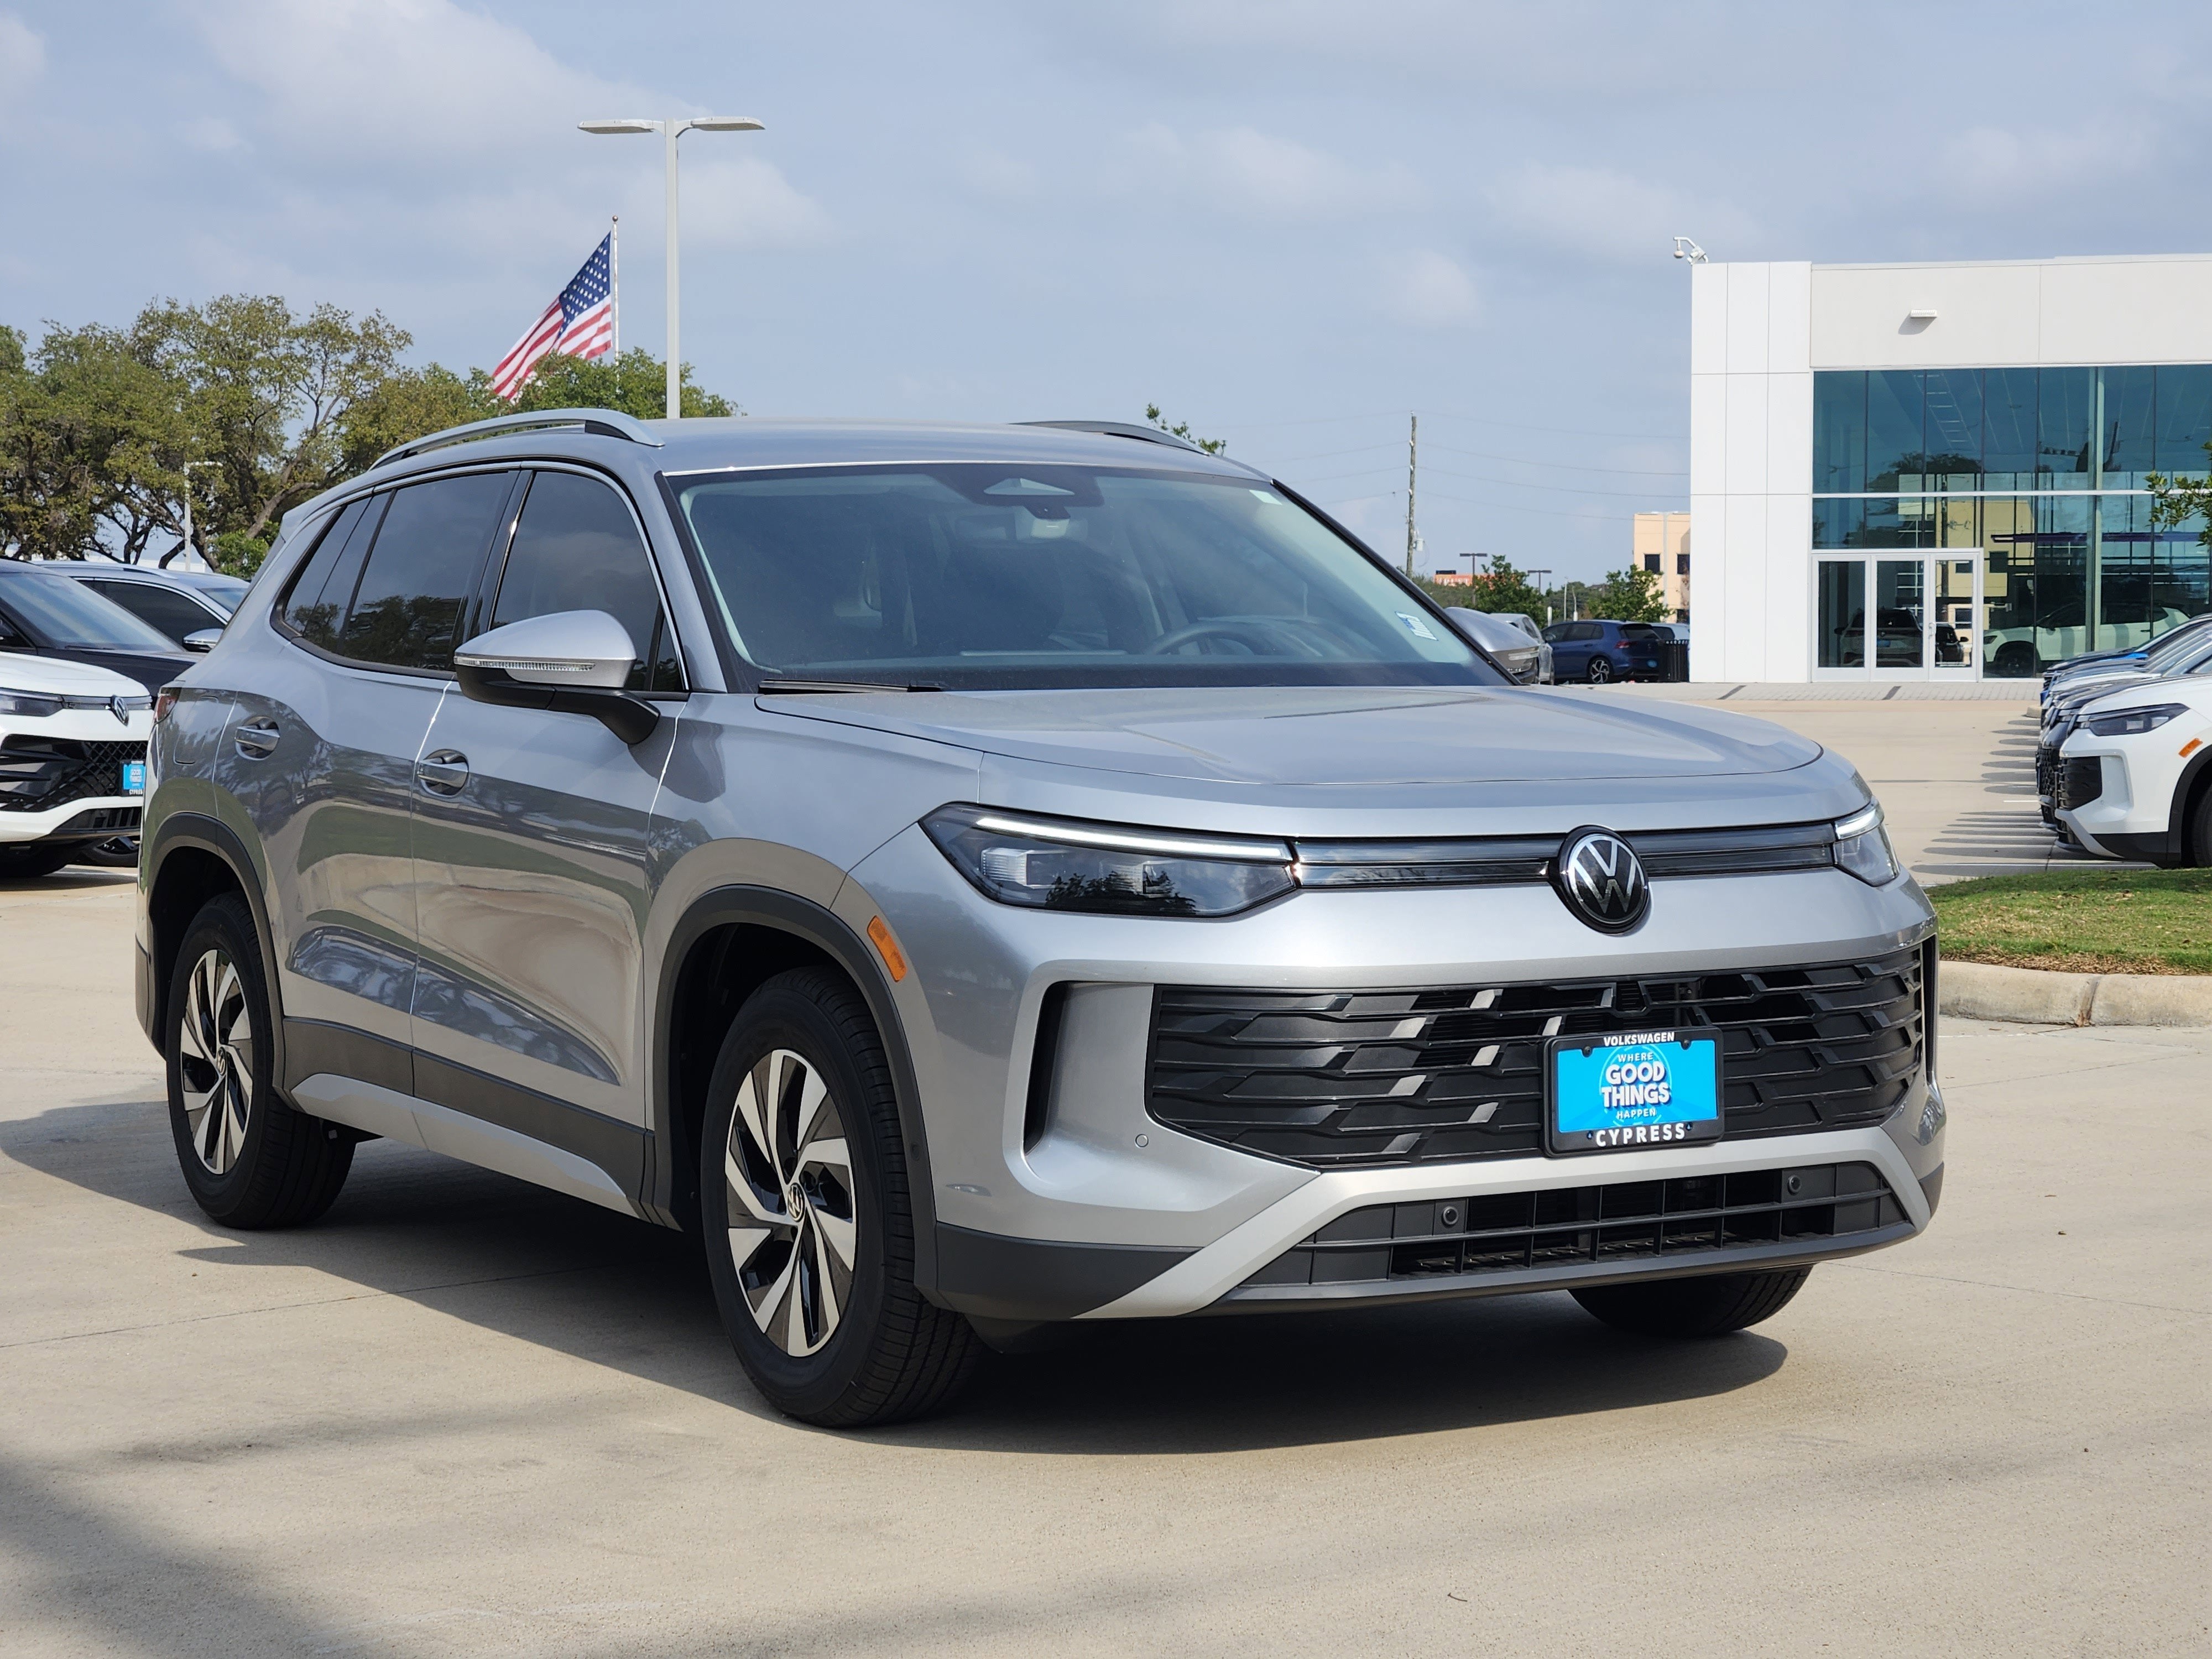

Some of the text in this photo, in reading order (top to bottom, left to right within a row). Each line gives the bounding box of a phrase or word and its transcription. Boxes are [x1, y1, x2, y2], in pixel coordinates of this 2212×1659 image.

[1571, 834, 1641, 917] VW
[1604, 1031, 1674, 1047] VOLKSWAGEN
[1618, 1052, 1653, 1062] WHERE
[1605, 1061, 1666, 1085] GOOD
[1601, 1082, 1670, 1108] THINGS
[1617, 1108, 1657, 1119] HAPPEN
[1596, 1123, 1685, 1147] CYPRESS
